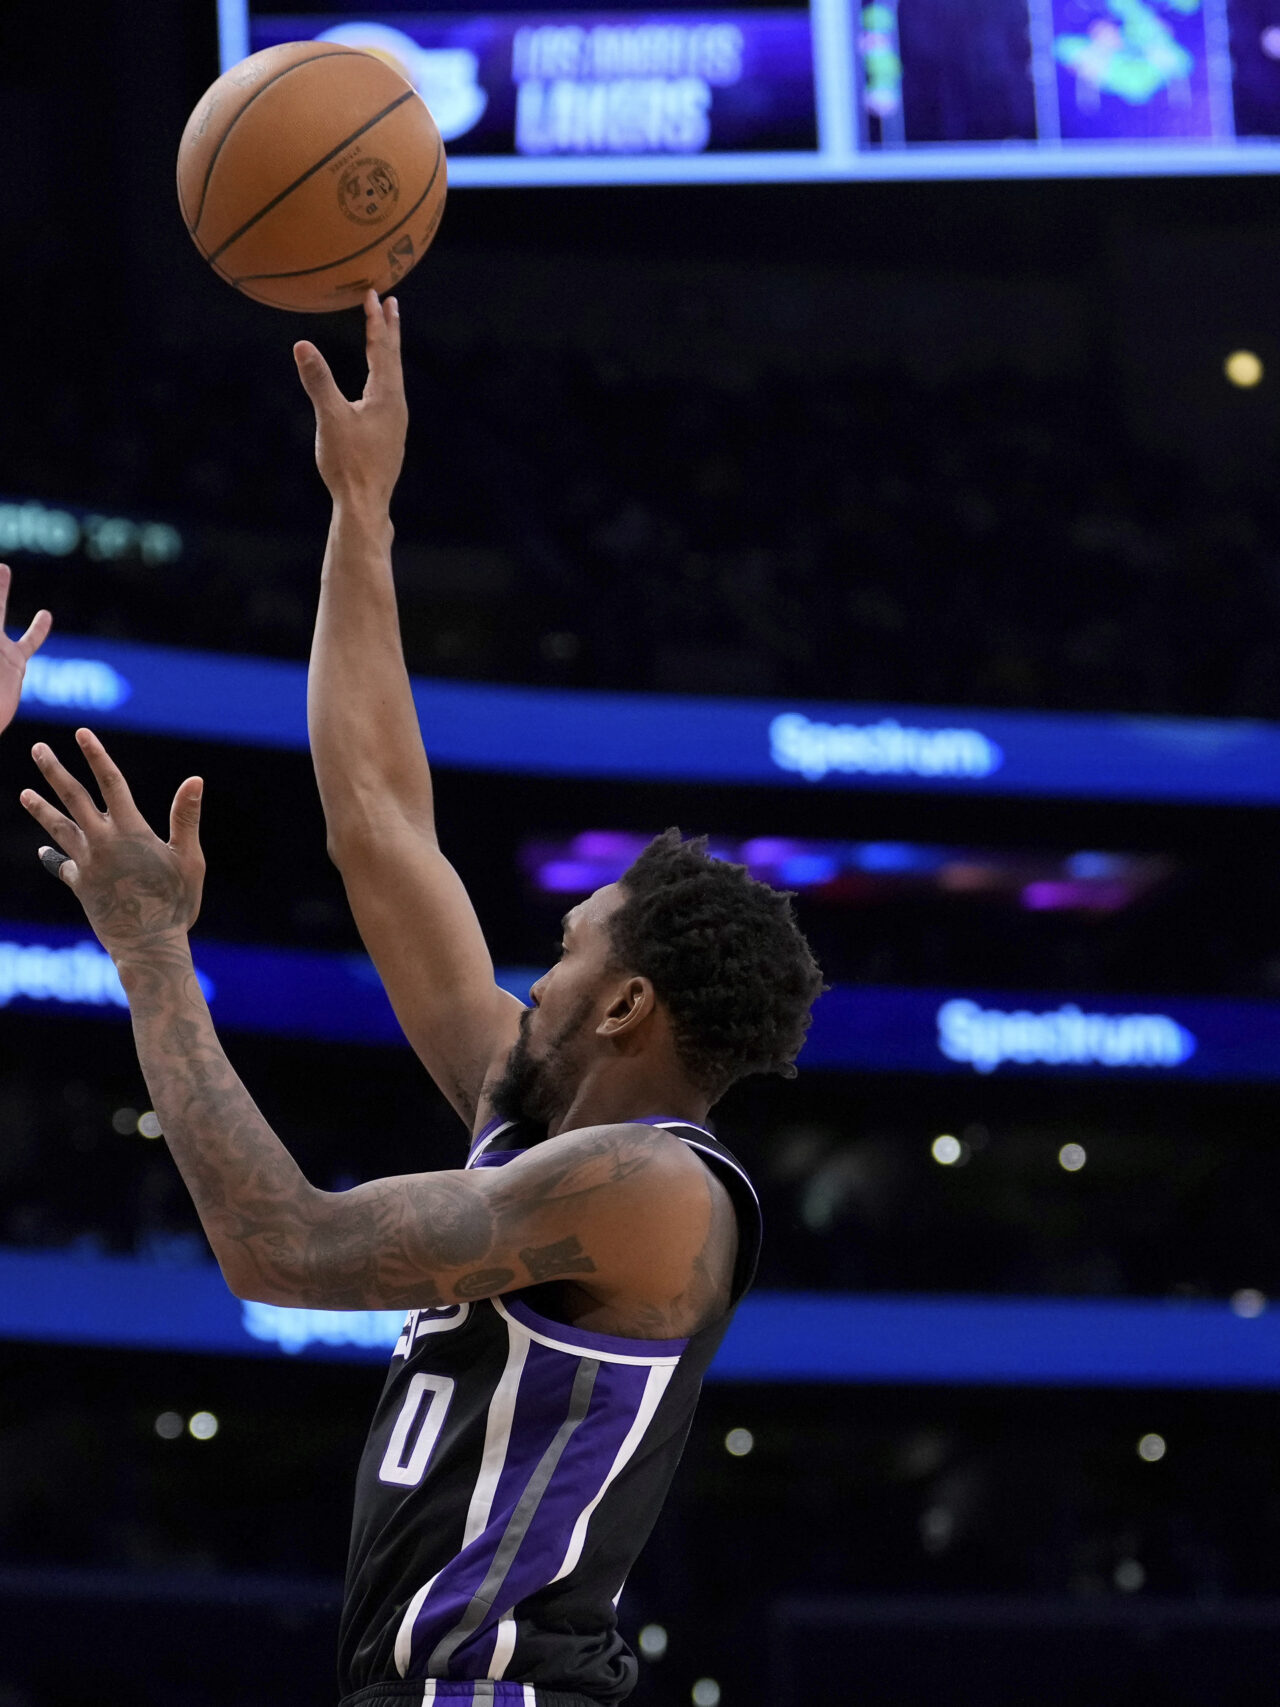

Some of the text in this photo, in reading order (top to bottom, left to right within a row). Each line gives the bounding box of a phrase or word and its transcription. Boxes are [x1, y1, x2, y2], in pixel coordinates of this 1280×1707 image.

[515, 78, 711, 154] LAKERS
[769, 713, 992, 781] Spectrum
[937, 999, 1183, 1073] Spectrum
[378, 1371, 456, 1488] 0
